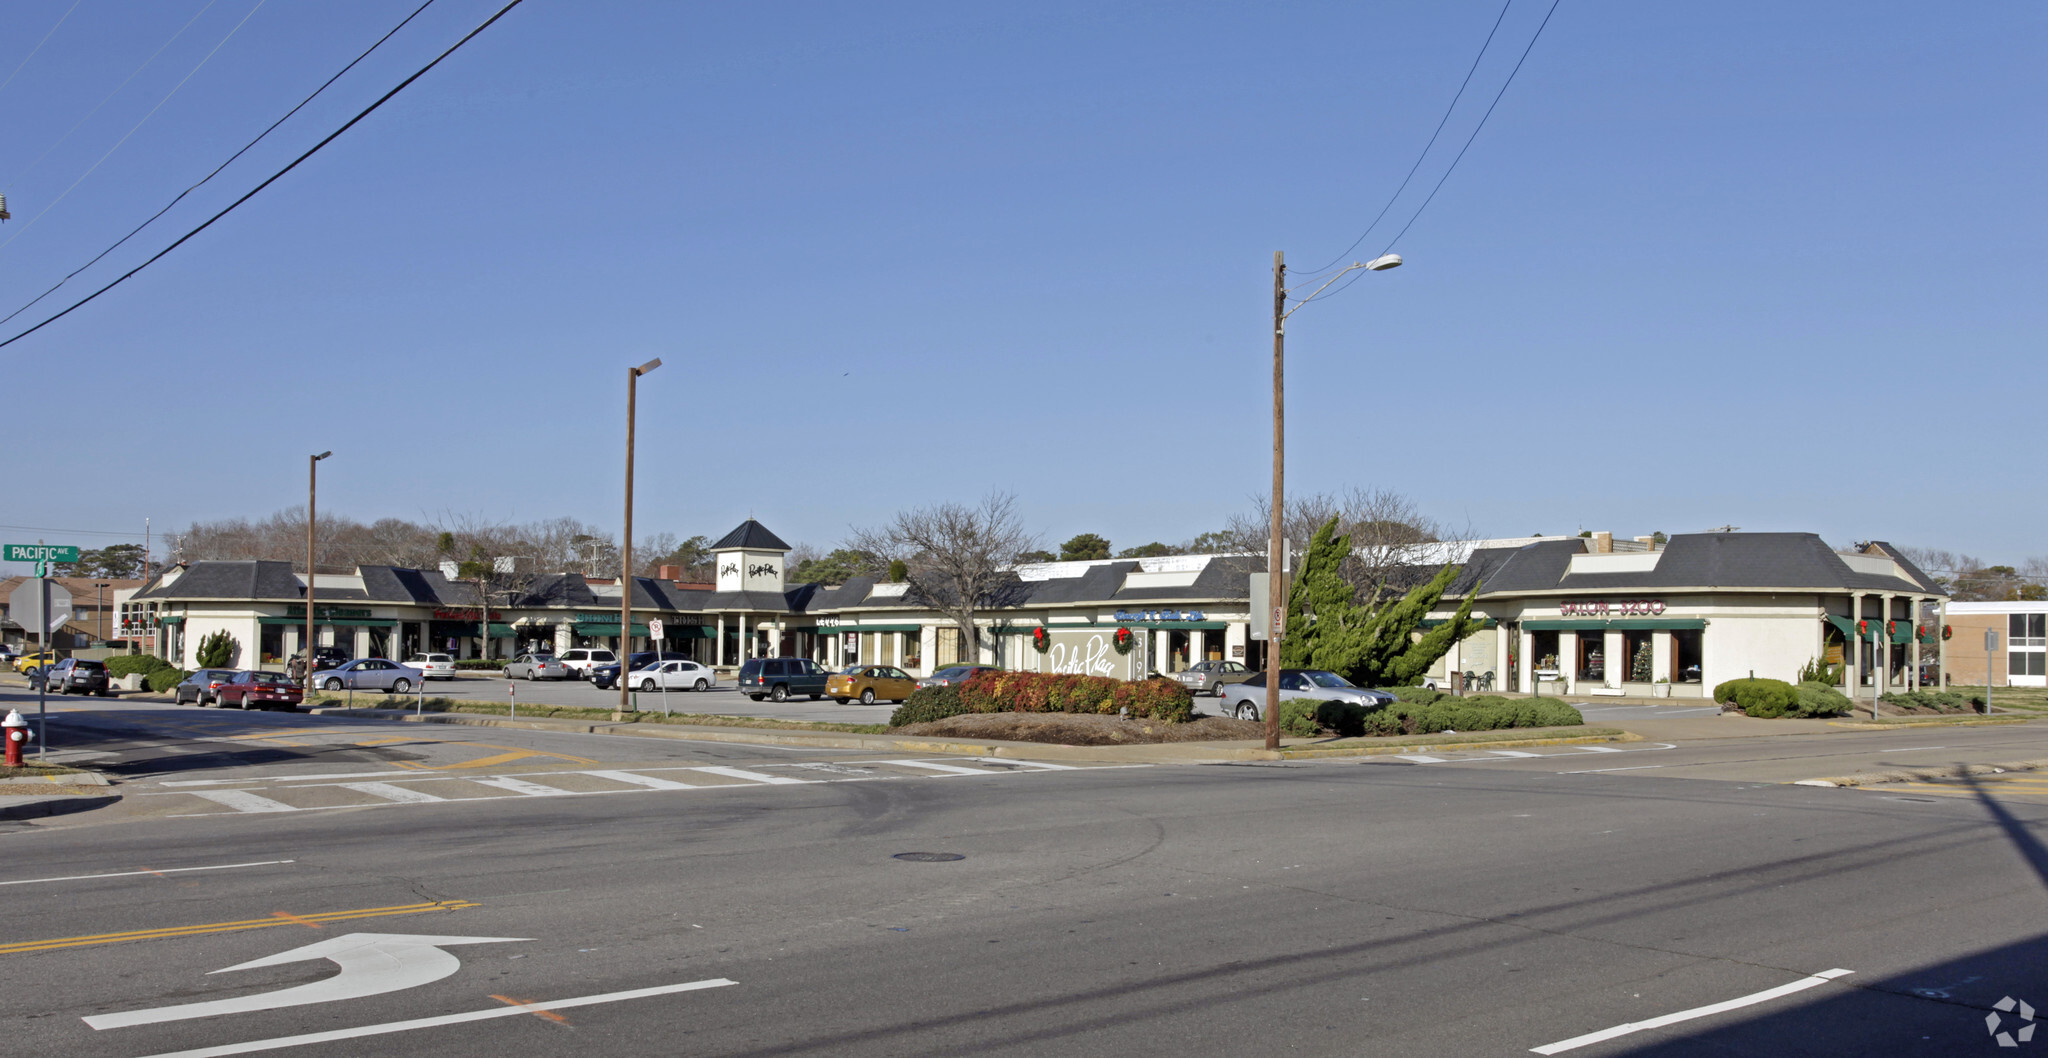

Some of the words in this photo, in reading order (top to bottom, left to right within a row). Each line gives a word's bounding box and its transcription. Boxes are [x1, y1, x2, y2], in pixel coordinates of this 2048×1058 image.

[12, 547, 57, 560] PACIFIC
[57, 547, 69, 555] AVE
[1560, 600, 1610, 615] SALON
[1620, 599, 1664, 614] 3200
